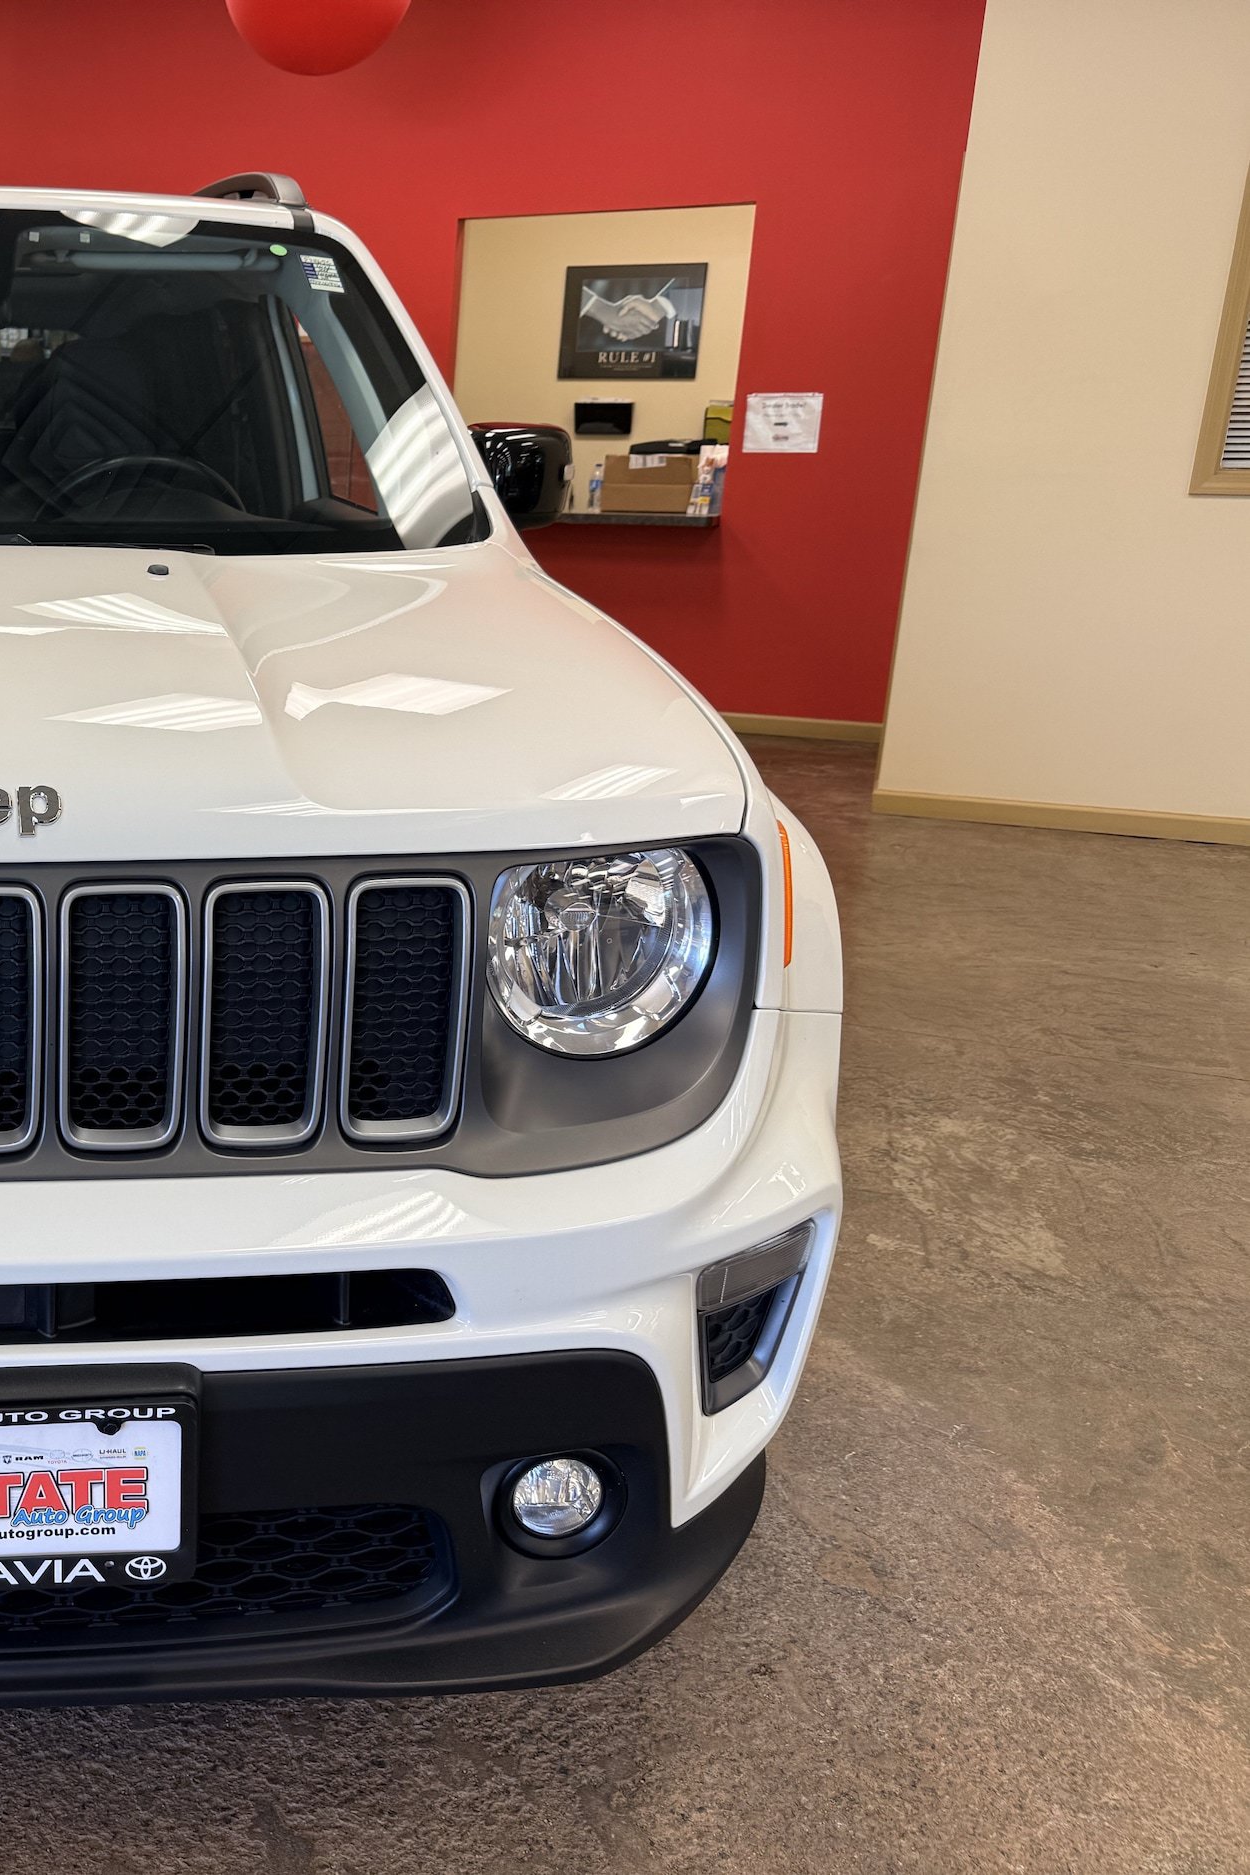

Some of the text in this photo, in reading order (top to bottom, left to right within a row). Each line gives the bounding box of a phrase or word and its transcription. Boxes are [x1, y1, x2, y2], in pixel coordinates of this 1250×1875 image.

[598, 351, 640, 364] RULE
[58, 1407, 176, 1421] GROUP
[11, 1504, 147, 1529] Auto Group
